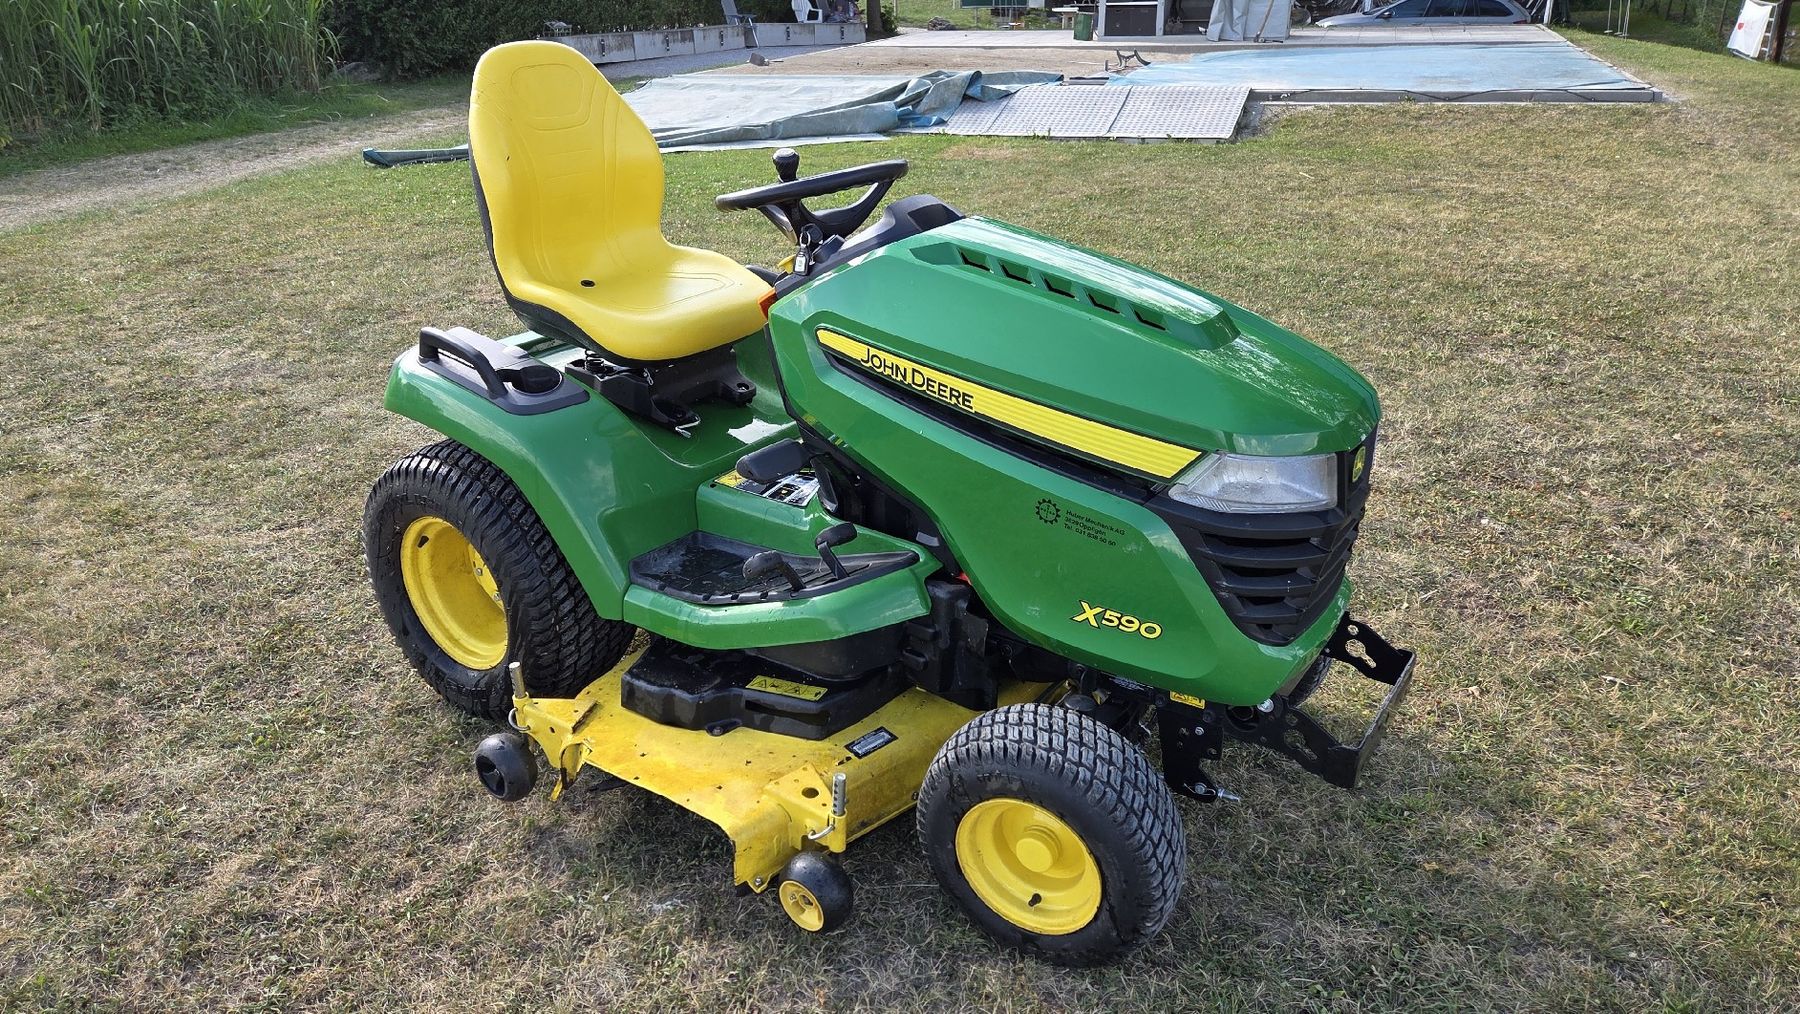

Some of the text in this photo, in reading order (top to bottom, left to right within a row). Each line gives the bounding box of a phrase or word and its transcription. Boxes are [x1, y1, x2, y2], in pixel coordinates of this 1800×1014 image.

[861, 347, 975, 411] JOHN DEERE
[1075, 527, 1086, 537] 031
[1114, 528, 1126, 536] AG
[1069, 599, 1163, 639] X590
